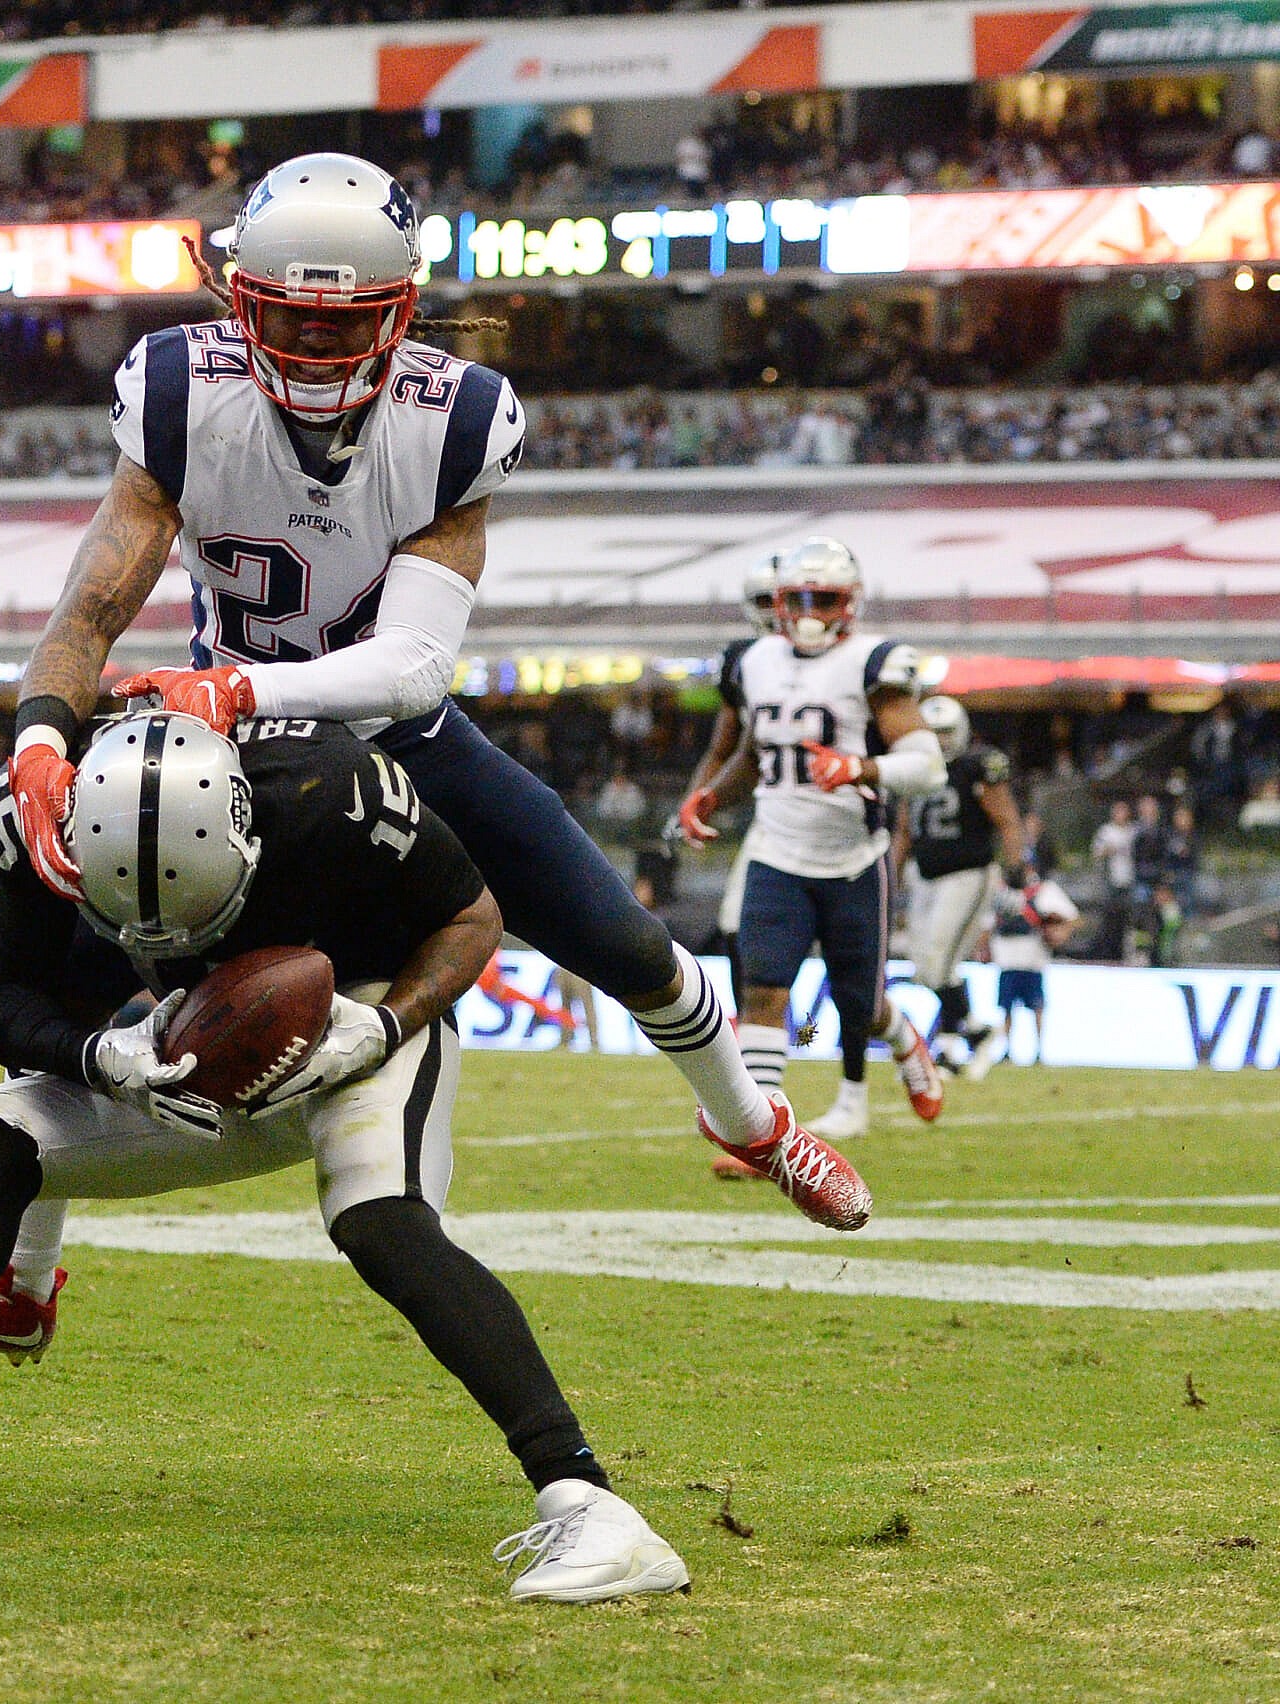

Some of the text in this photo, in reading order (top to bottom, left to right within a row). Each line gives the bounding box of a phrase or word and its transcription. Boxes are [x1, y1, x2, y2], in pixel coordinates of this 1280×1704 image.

[468, 217, 607, 278] 11:43
[390, 347, 459, 412] 24
[288, 513, 352, 538] PATRIOTS
[370, 753, 420, 861] 15
